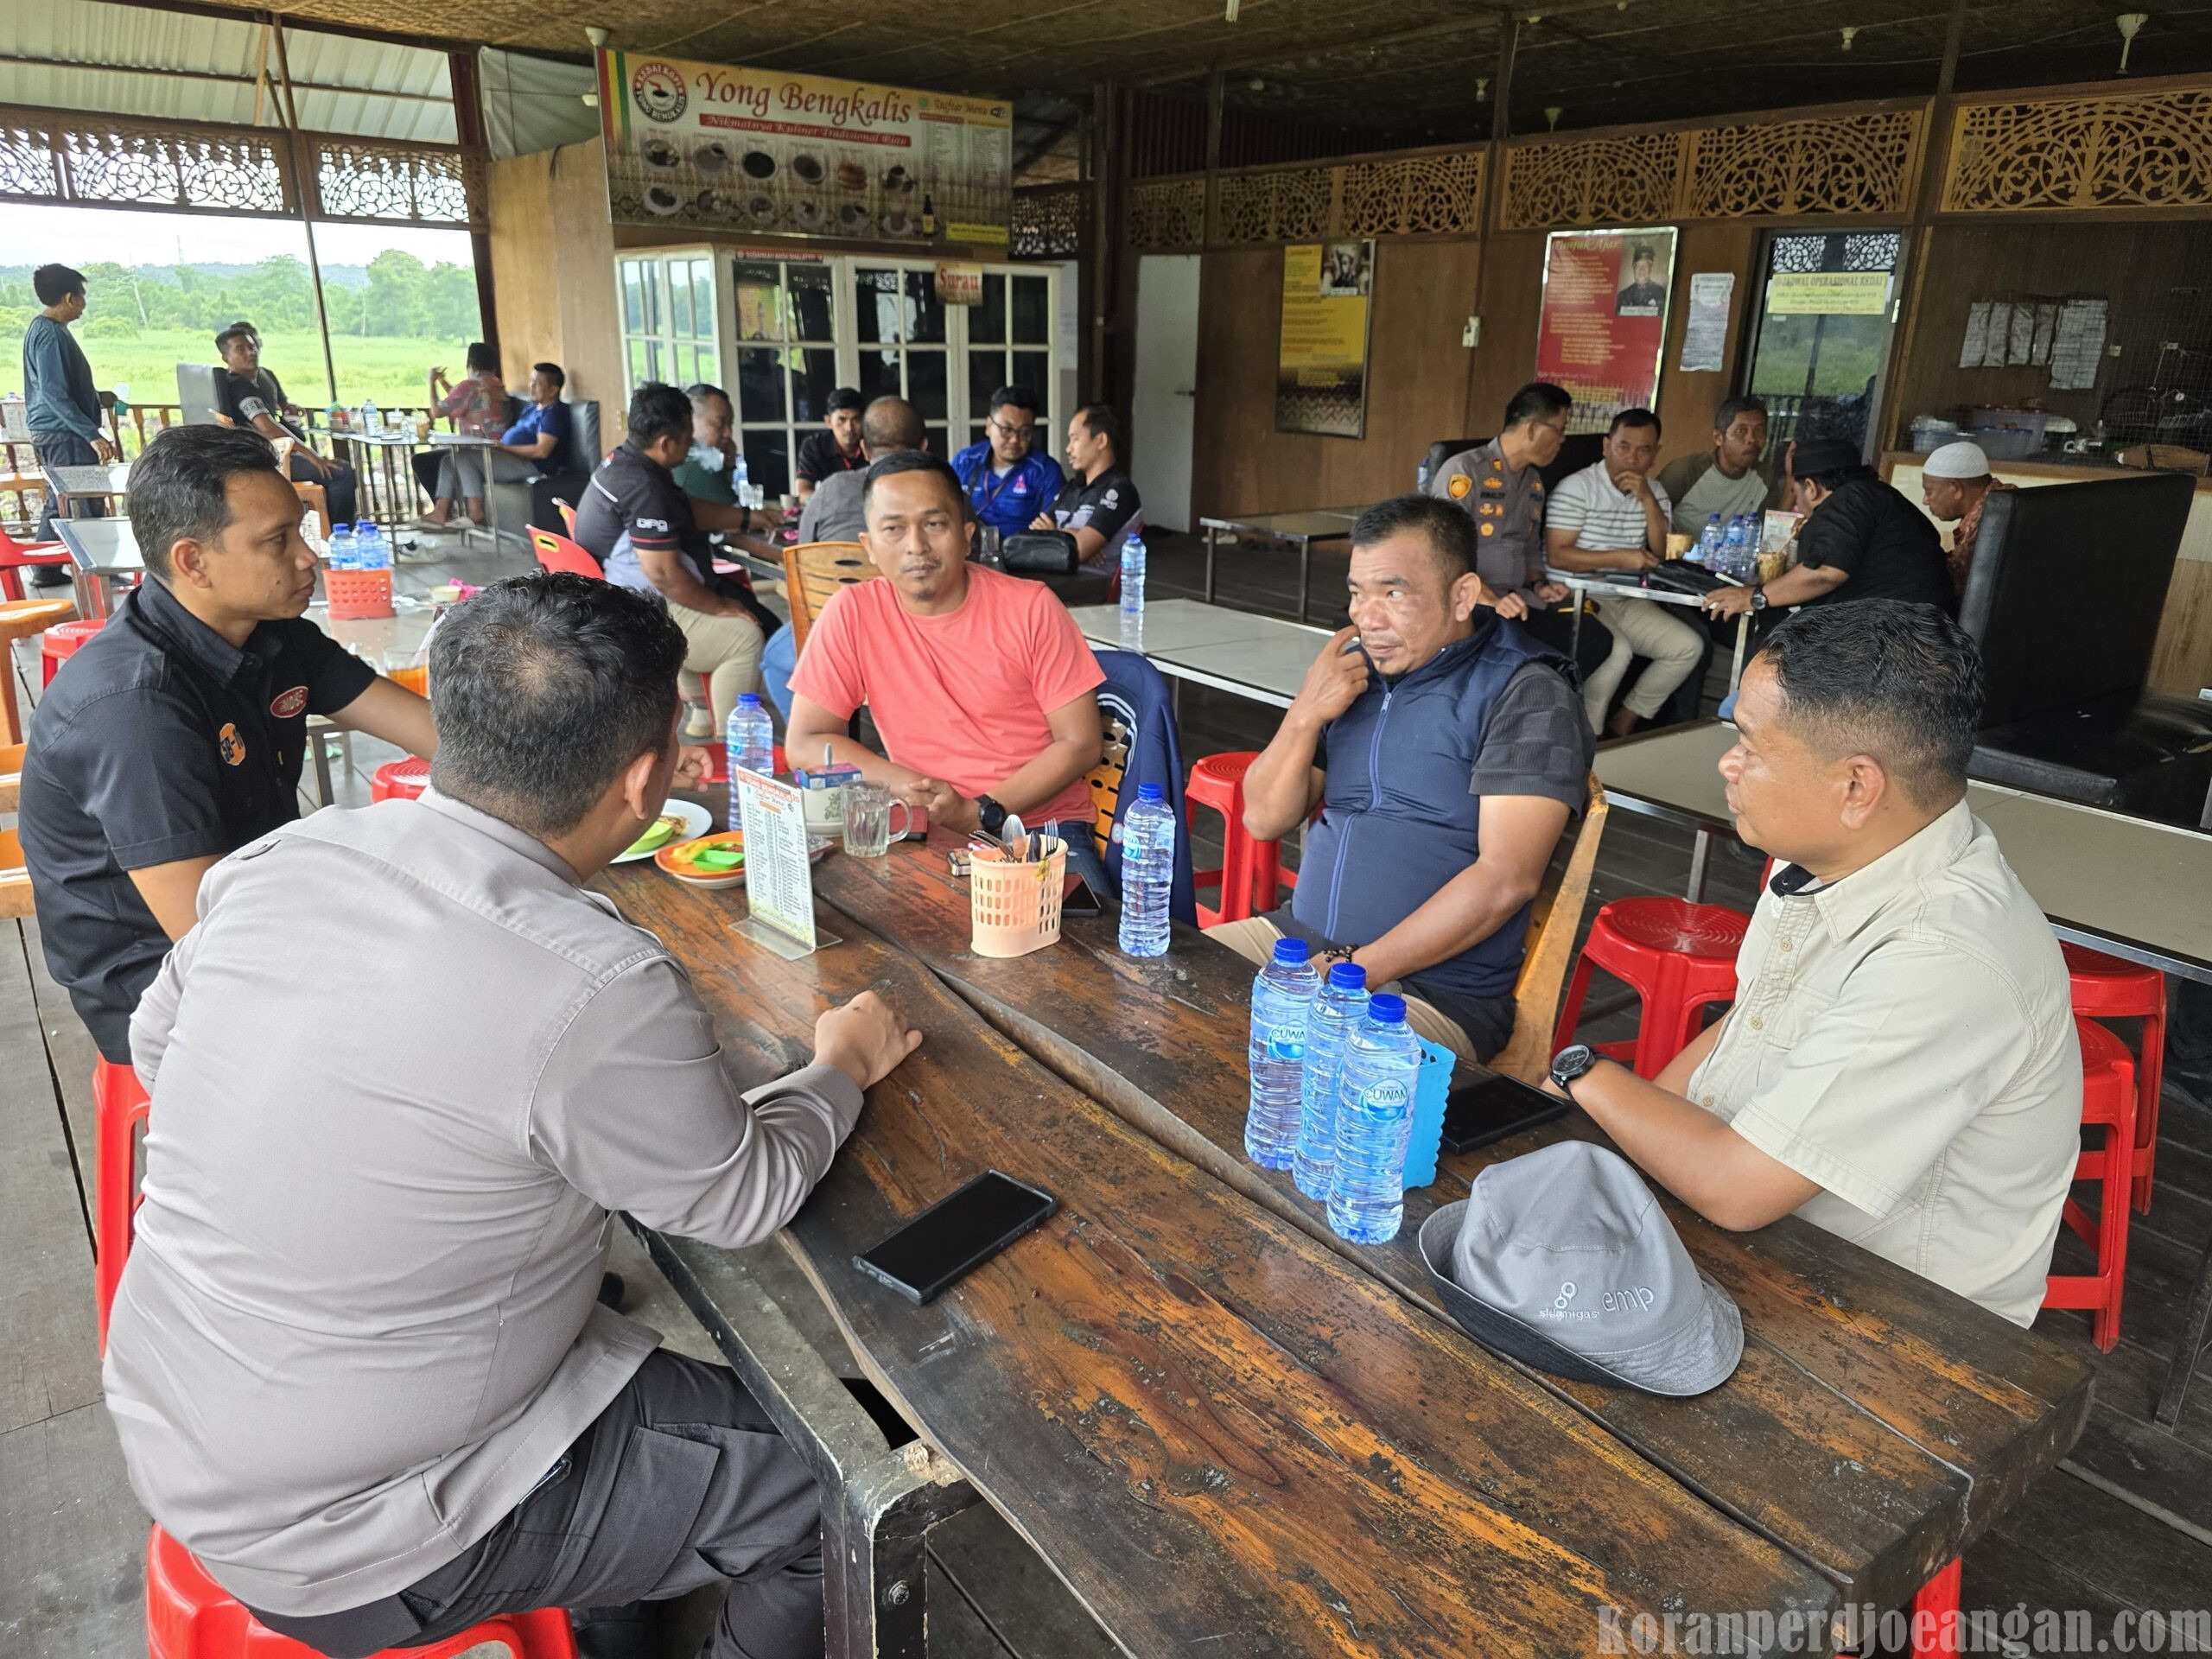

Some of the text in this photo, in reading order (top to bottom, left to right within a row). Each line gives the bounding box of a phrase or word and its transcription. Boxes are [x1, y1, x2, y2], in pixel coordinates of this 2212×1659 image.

[696, 71, 912, 127] Yong Bengkalis
[938, 266, 980, 291] Surau
[1601, 1286, 1655, 1312] emp
